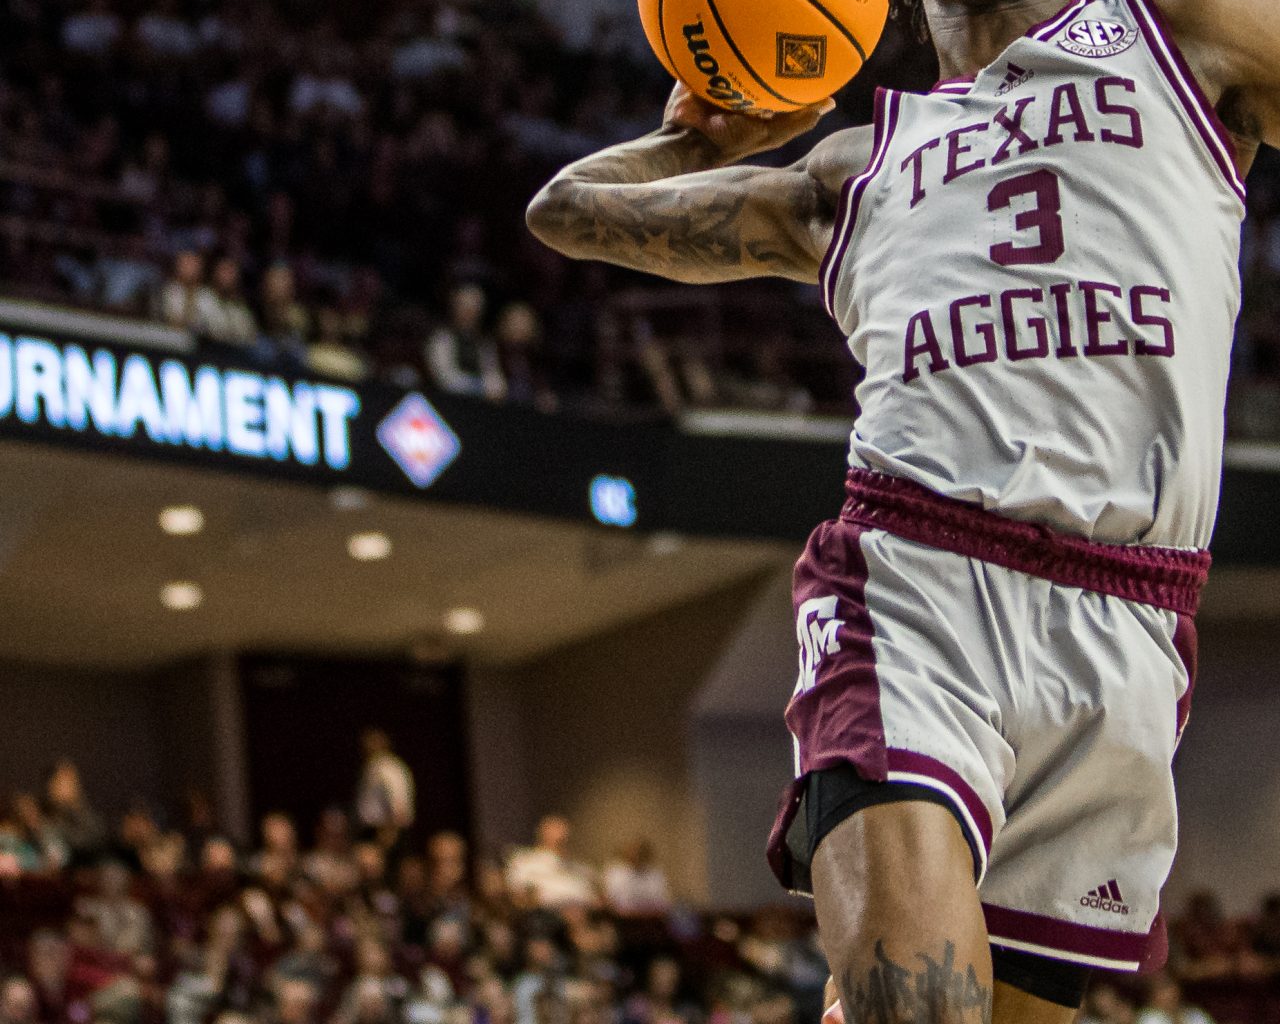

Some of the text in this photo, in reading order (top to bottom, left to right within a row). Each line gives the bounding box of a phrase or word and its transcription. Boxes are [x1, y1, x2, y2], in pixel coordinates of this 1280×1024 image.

[1070, 20, 1122, 46] SEC
[901, 76, 1144, 209] TEXAS
[987, 169, 1065, 266] 3
[903, 281, 1175, 383] AGGIES
[1080, 896, 1129, 915] adidas
